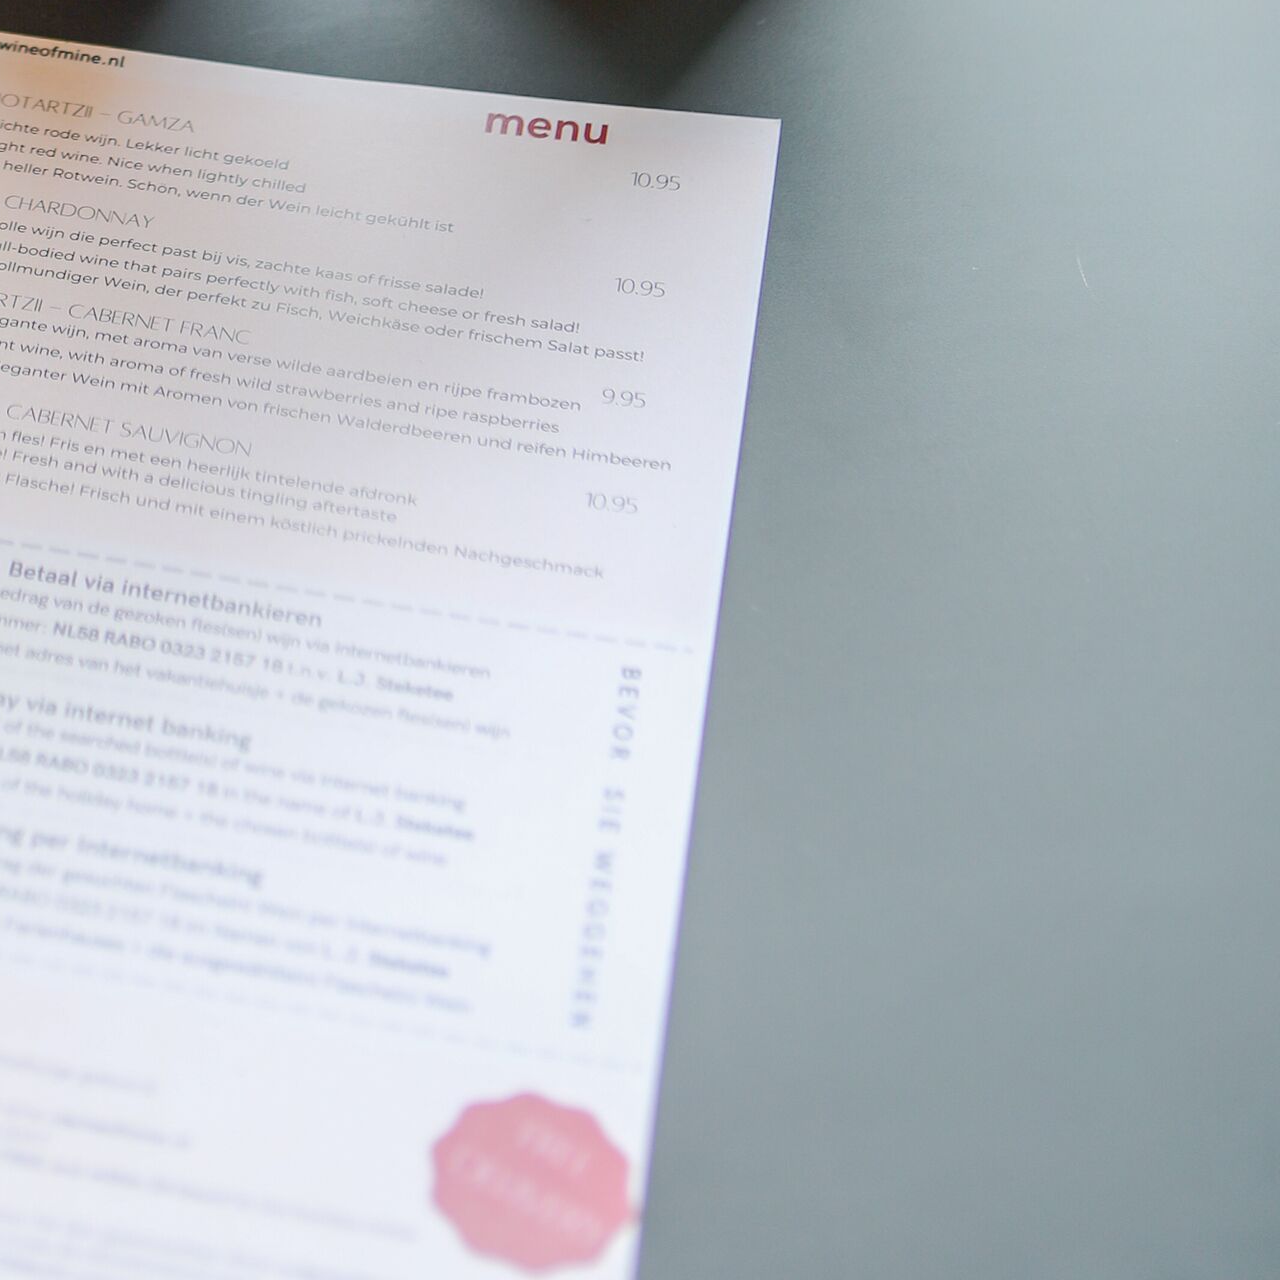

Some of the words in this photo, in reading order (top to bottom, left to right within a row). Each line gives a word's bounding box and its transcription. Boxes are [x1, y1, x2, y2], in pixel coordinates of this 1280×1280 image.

[116, 109, 194, 133] GAMZA
[483, 111, 610, 145] menu
[29, 146, 57, 158] red
[60, 151, 103, 164] wine.
[106, 156, 143, 170] Nice
[147, 163, 192, 177] when
[196, 168, 248, 187] lightly
[251, 177, 306, 193] chilled
[43, 128, 80, 141] rode
[84, 134, 120, 147] wijn.
[125, 138, 180, 154] Lekker
[184, 146, 219, 161] licht
[222, 153, 290, 170] gekoeld
[630, 170, 682, 193] 10.95
[3, 194, 154, 229] CHARDONNAY
[30, 225, 64, 240] wijn
[68, 230, 94, 243] die
[98, 236, 157, 253] perfect
[160, 246, 197, 259] past
[201, 249, 221, 265] bij
[225, 254, 250, 268] vis,
[254, 259, 310, 275] zachte
[314, 265, 352, 281] kaas
[356, 272, 375, 284] of
[377, 274, 421, 291] frisse
[424, 283, 484, 299] salade!
[615, 277, 667, 300] 10.95
[67, 303, 175, 332] CABERNET
[178, 319, 250, 345] FRANC
[104, 275, 149, 294] Wein,
[154, 284, 182, 297] der
[186, 290, 246, 308] perfekt
[250, 300, 271, 311] zu
[275, 301, 322, 320] Fisch,
[328, 309, 420, 333] Weichkäse
[423, 324, 464, 338] oder
[468, 328, 542, 349] frischem
[546, 339, 589, 355] Salat
[593, 347, 644, 362] passt!
[19, 343, 62, 360] wine,
[68, 350, 104, 365] with
[109, 357, 164, 374] aroma
[168, 365, 186, 377] of
[189, 367, 231, 385] fresh
[236, 376, 272, 391] wild
[275, 383, 382, 408] strawberries
[385, 400, 420, 414] and
[424, 403, 458, 419] ripe
[462, 410, 559, 433] raspberries
[601, 387, 647, 410] 9.95
[6, 403, 114, 434] CABERNET
[119, 421, 252, 457] SAUVIGNON
[584, 490, 639, 516] 10.95
[8, 559, 78, 587] Betaal
[84, 574, 114, 593] via
[121, 579, 322, 628] internetbankieren
[26, 696, 58, 716] via
[63, 701, 154, 732] internet
[160, 716, 252, 754] banking
